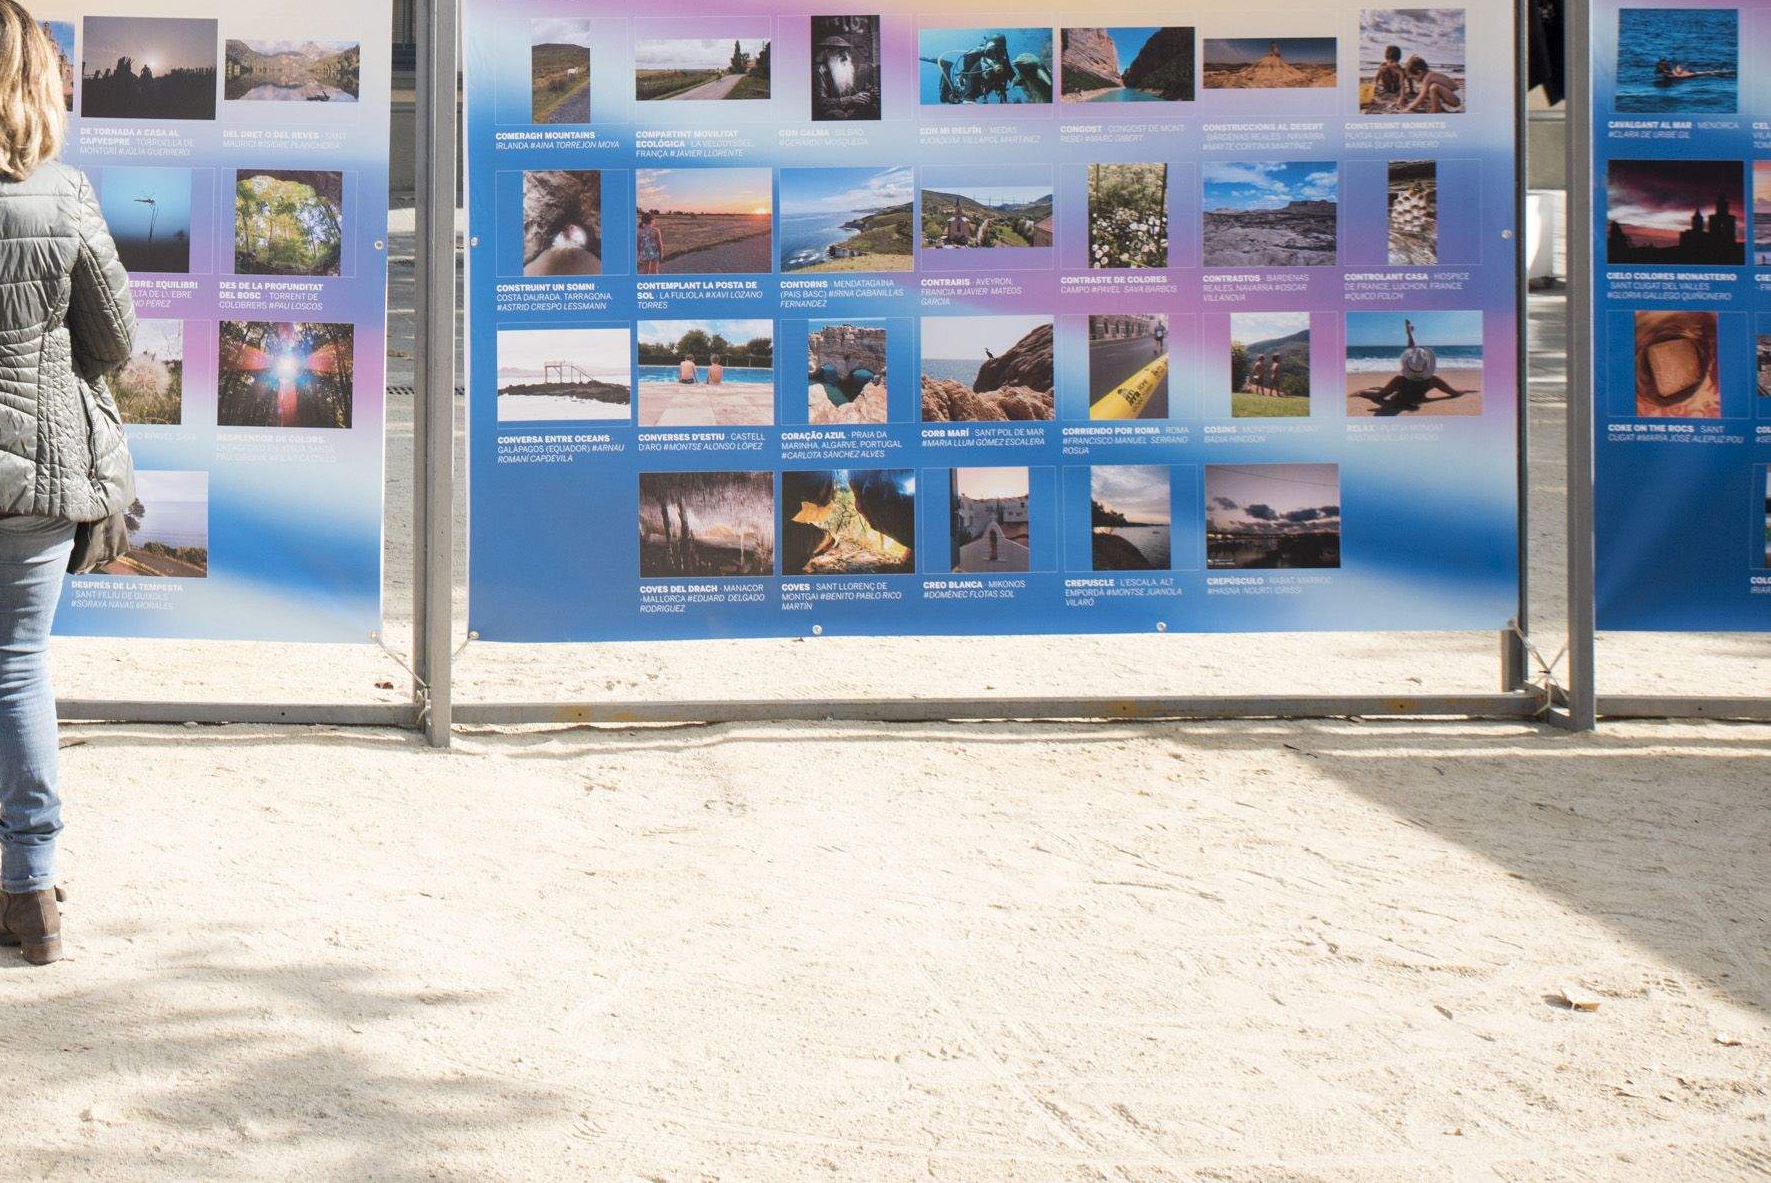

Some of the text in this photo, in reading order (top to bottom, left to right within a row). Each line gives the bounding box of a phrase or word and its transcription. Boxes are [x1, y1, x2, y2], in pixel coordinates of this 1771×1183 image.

[496, 131, 596, 140] COMERAGH MOUNTAINS
[1060, 275, 1167, 285] CONTRASTE DE COLORES
[1634, 272, 1675, 281] COLORES
[496, 283, 594, 293] CONSTRUINT UN SOMNI
[636, 281, 758, 290] CONTEMPLANT LA POSTA DE
[921, 427, 1044, 438] CORB MARÍ SANT POL DE MAR
[1634, 424, 1647, 433] ON
[1649, 424, 1666, 433] THE
[1700, 424, 1725, 433] SANT
[498, 434, 610, 444] CONVERSA ENTRE OCEANS
[638, 432, 766, 442] CONVERSES D'ESTIU CASTELL
[781, 429, 888, 443] CORAÇÃO AZUL PRAIA DA
[640, 583, 764, 594] COVES DEL DRACH MANACOR
[923, 579, 1026, 589] CREO BLANCA MIKONOS
